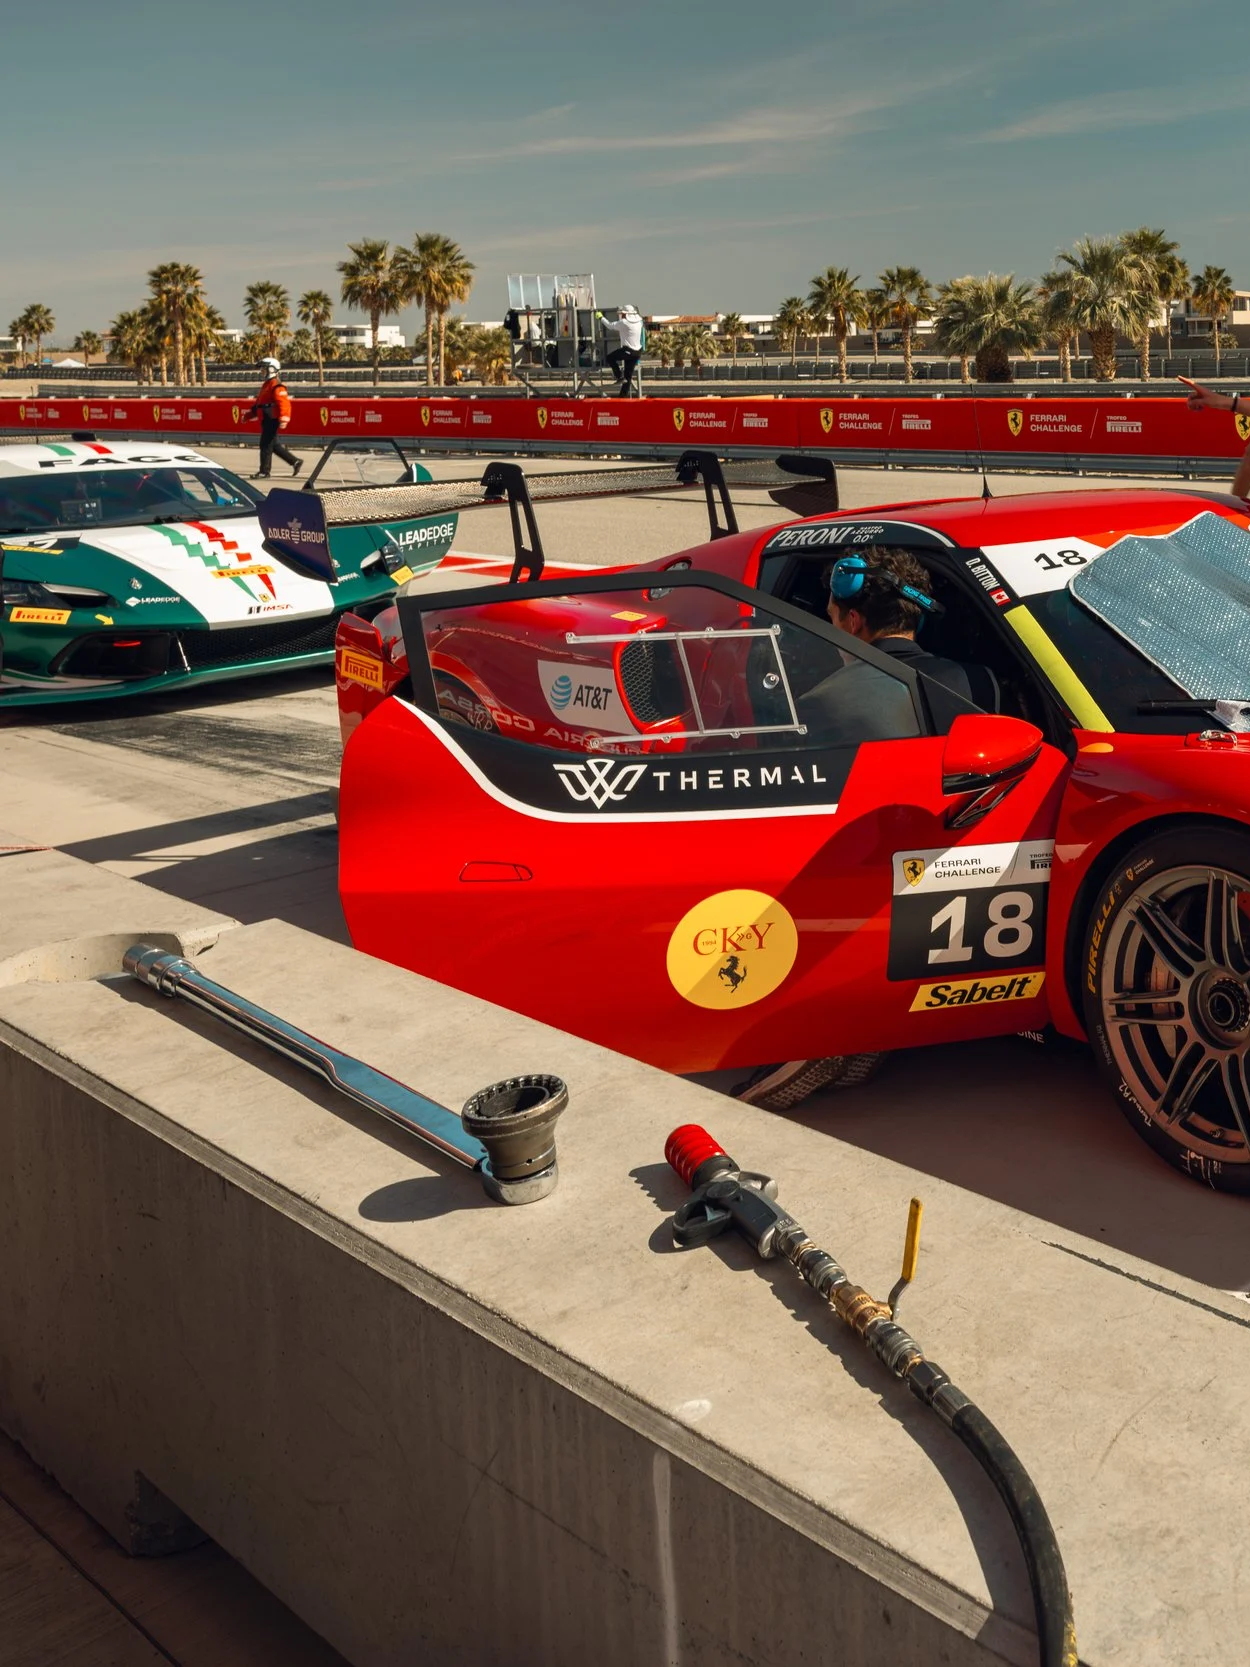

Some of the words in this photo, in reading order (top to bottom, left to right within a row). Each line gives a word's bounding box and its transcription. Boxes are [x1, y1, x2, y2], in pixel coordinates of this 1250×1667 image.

[689, 420, 727, 428] CHALLENGE
[838, 413, 870, 421] FERRARI
[839, 421, 883, 430] CHALLENGE
[902, 419, 931, 430] PIRELLI
[1029, 414, 1067, 422] FERRARI
[1030, 424, 1083, 433] CHALLENGE
[1106, 421, 1142, 433] PIRELLI
[268, 527, 290, 541] ADLER
[301, 531, 325, 544] GROUP
[399, 522, 454, 546] LEADEDGE
[766, 526, 855, 548] PERONI
[1034, 549, 1088, 571] 18
[971, 564, 1000, 591] BITTON
[15, 610, 64, 621] PIRELLI
[344, 656, 379, 682] PIRELLI
[573, 684, 612, 711] AT&T
[653, 764, 828, 792] THERMAL
[934, 858, 982, 869] FERRARI
[935, 865, 1001, 879] CHALLENGE
[927, 891, 1034, 965] 18
[1087, 890, 1115, 994] PIRELLI
[925, 975, 1032, 1008] Sabelt
